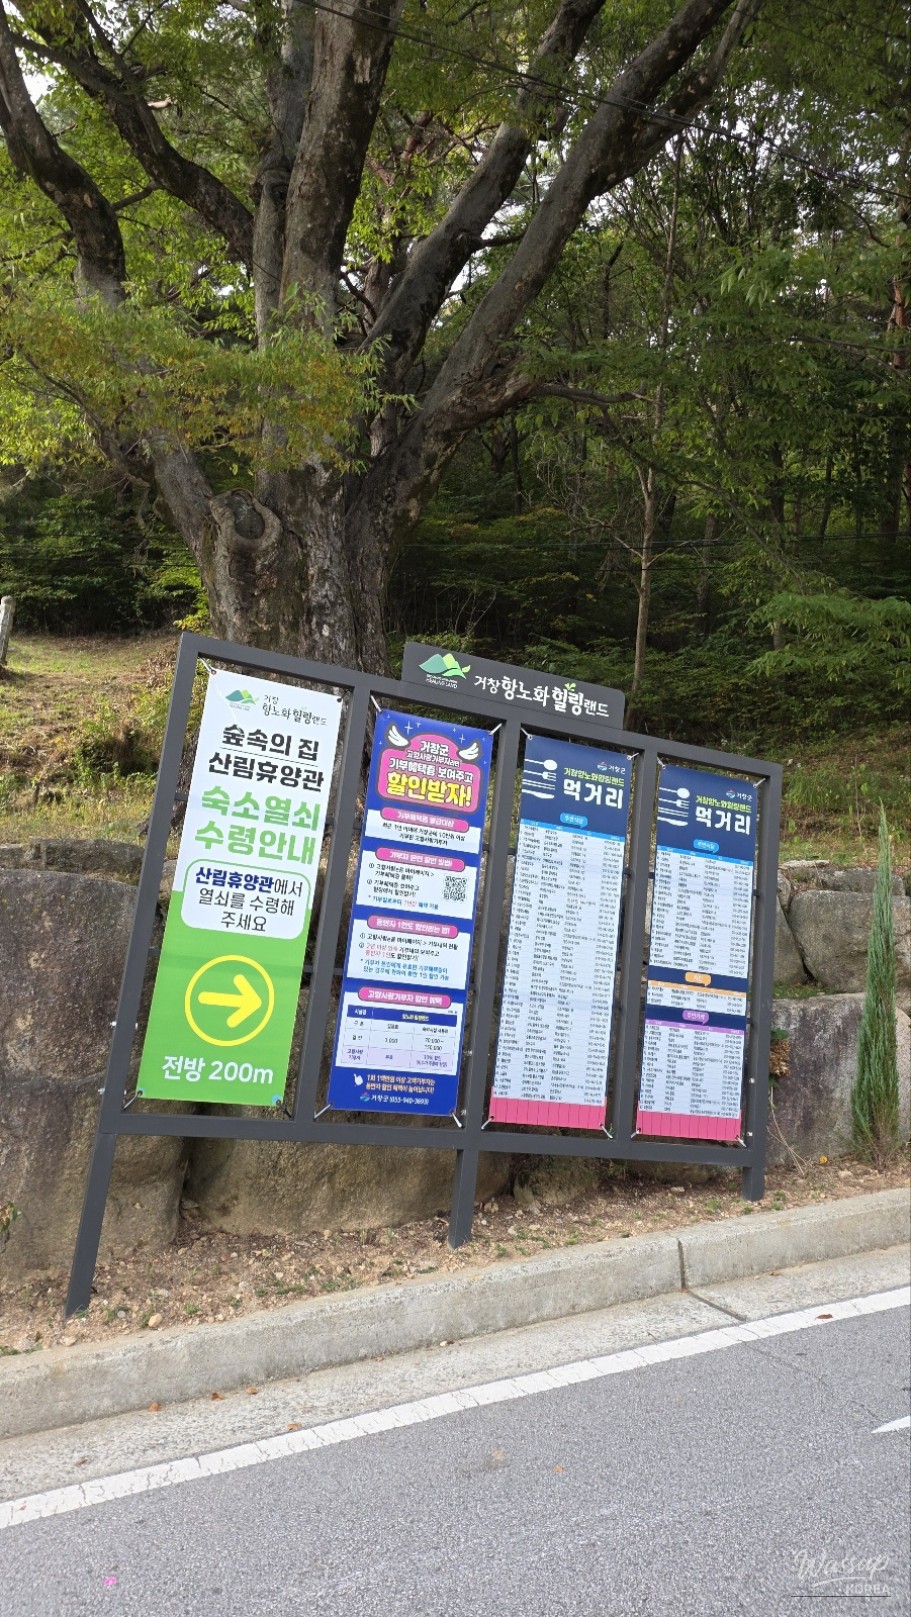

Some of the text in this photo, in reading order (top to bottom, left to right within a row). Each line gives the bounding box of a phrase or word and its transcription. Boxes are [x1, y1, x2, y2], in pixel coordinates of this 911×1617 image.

[222, 724, 319, 761] 숲속의 집
[419, 740, 449, 756] 거창군
[208, 752, 324, 793] 산림휴양관
[388, 757, 473, 783] 기부혜택증 보여주고
[387, 772, 472, 807] 할인받자!
[562, 778, 623, 809] 먹거리
[202, 786, 321, 832] 숙소열쇠
[695, 805, 750, 835] 먹거리
[195, 821, 316, 864] 수령안내
[194, 866, 303, 897] 산림휴양관에서
[197, 887, 295, 916] 열쇠를 수령해
[219, 911, 267, 932] 주세요
[162, 1056, 274, 1084] 전방 200m
